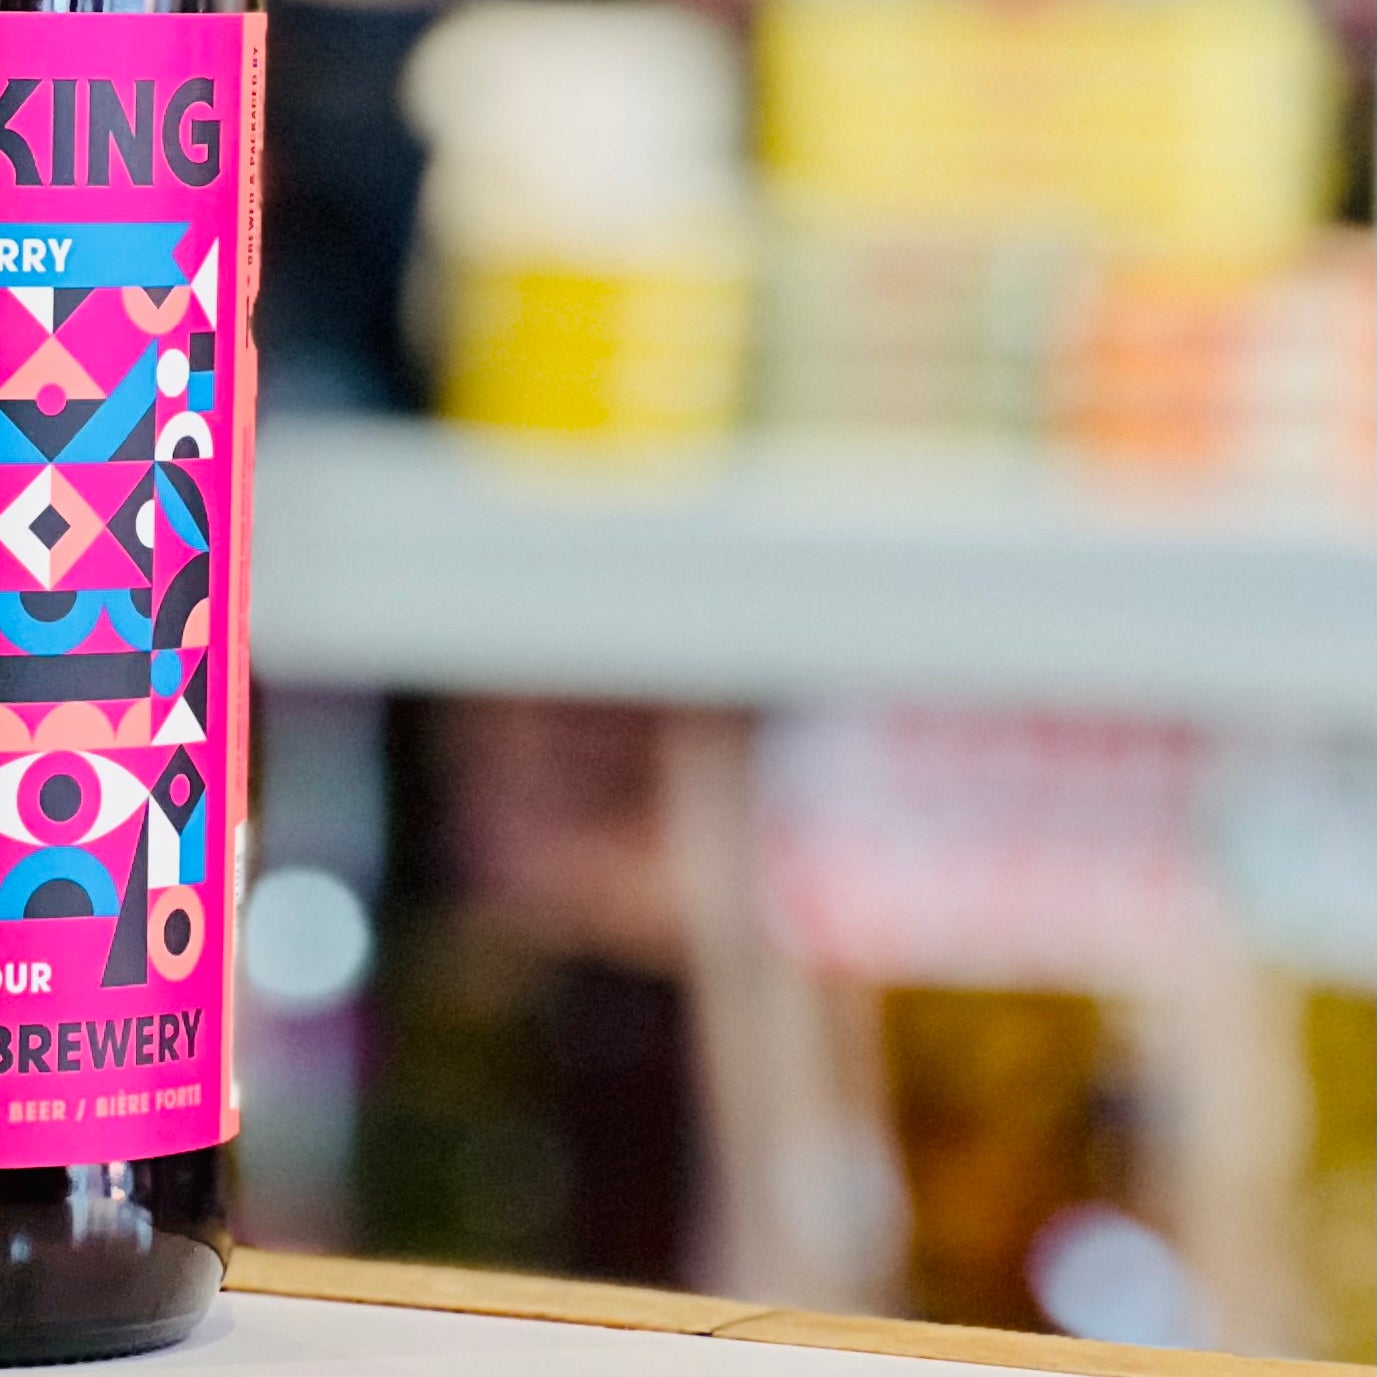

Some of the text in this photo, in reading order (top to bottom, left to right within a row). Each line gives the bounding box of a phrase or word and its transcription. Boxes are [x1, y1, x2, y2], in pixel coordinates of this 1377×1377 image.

[8, 1099, 66, 1122] BEER
[75, 1098, 86, 1121] /
[95, 1089, 149, 1118] BIÈRE
[155, 1083, 202, 1111] FORTE
